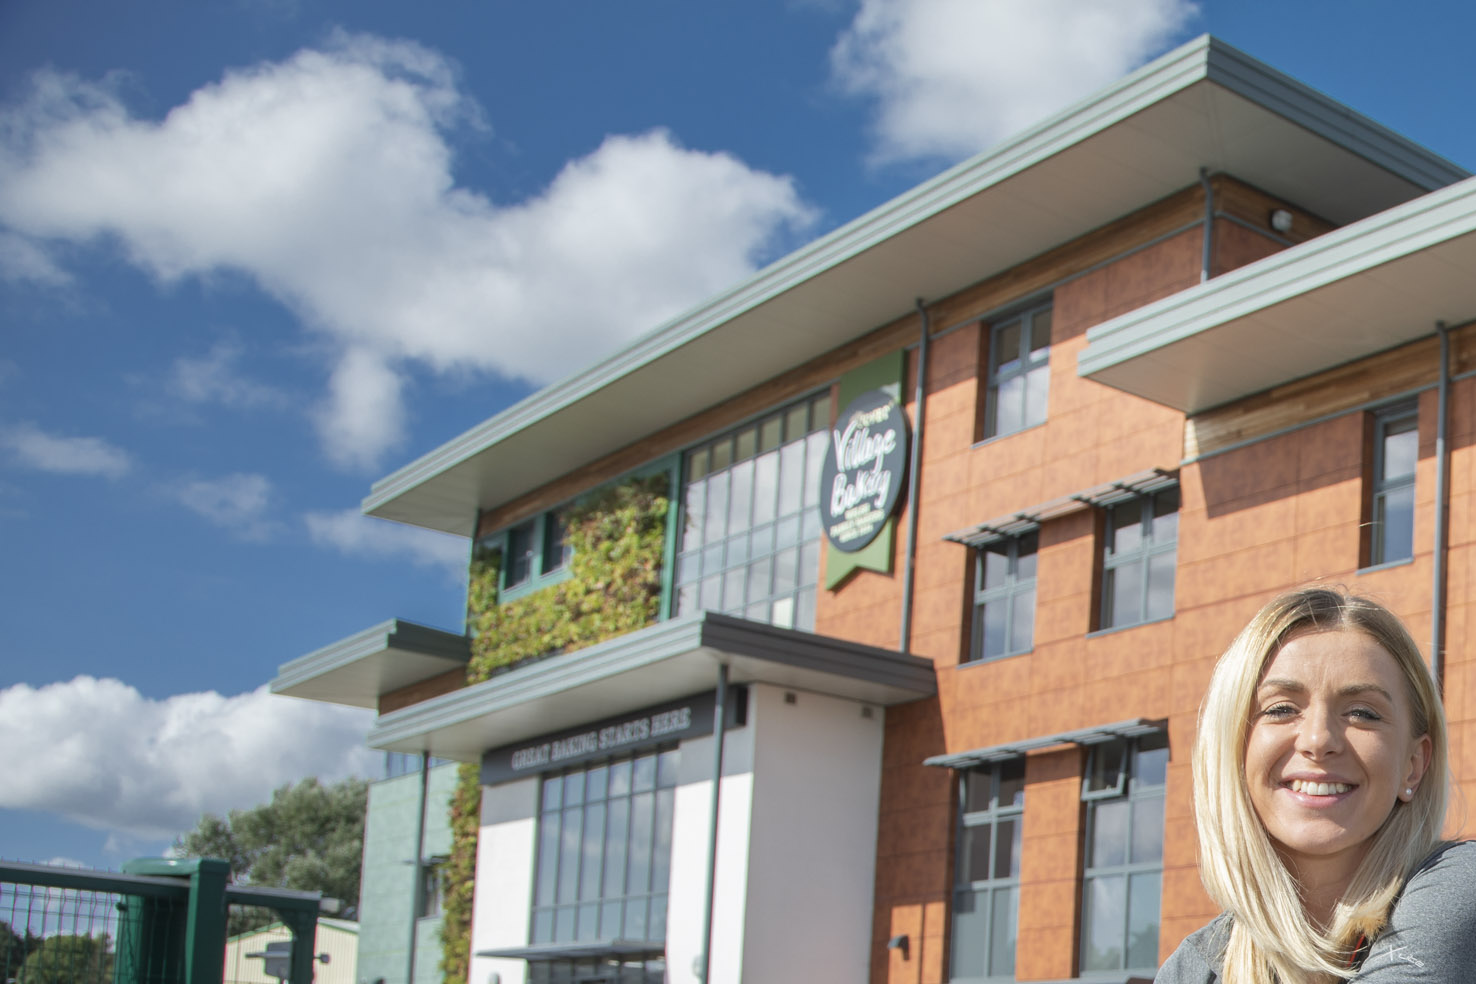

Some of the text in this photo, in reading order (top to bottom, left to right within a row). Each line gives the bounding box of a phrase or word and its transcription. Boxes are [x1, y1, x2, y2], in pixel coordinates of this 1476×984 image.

[834, 421, 896, 474] Village
[830, 470, 891, 517] Bakery
[512, 707, 691, 770] GREAT BAKING STARTS HERE
